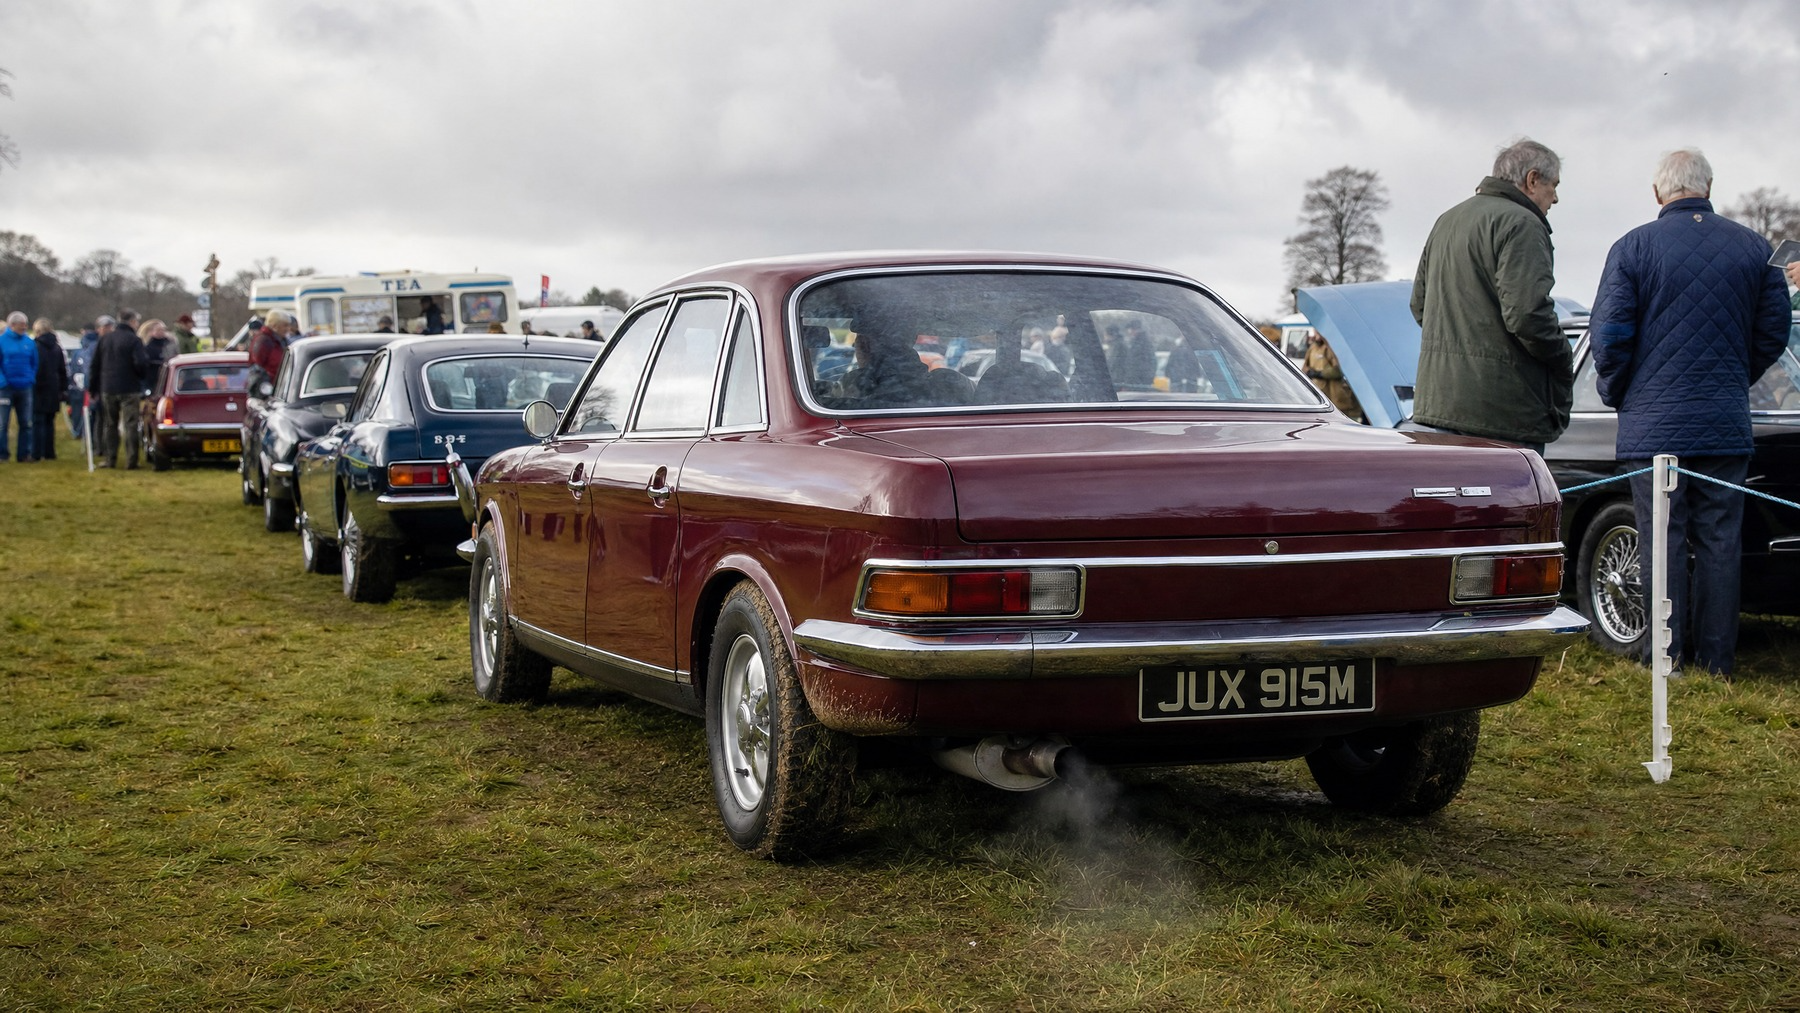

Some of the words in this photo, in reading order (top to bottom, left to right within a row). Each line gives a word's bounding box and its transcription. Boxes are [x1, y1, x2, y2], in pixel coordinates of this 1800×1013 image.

[381, 279, 421, 291] TEA
[1157, 669, 1246, 712] JUX
[1260, 665, 1355, 708] 915M
